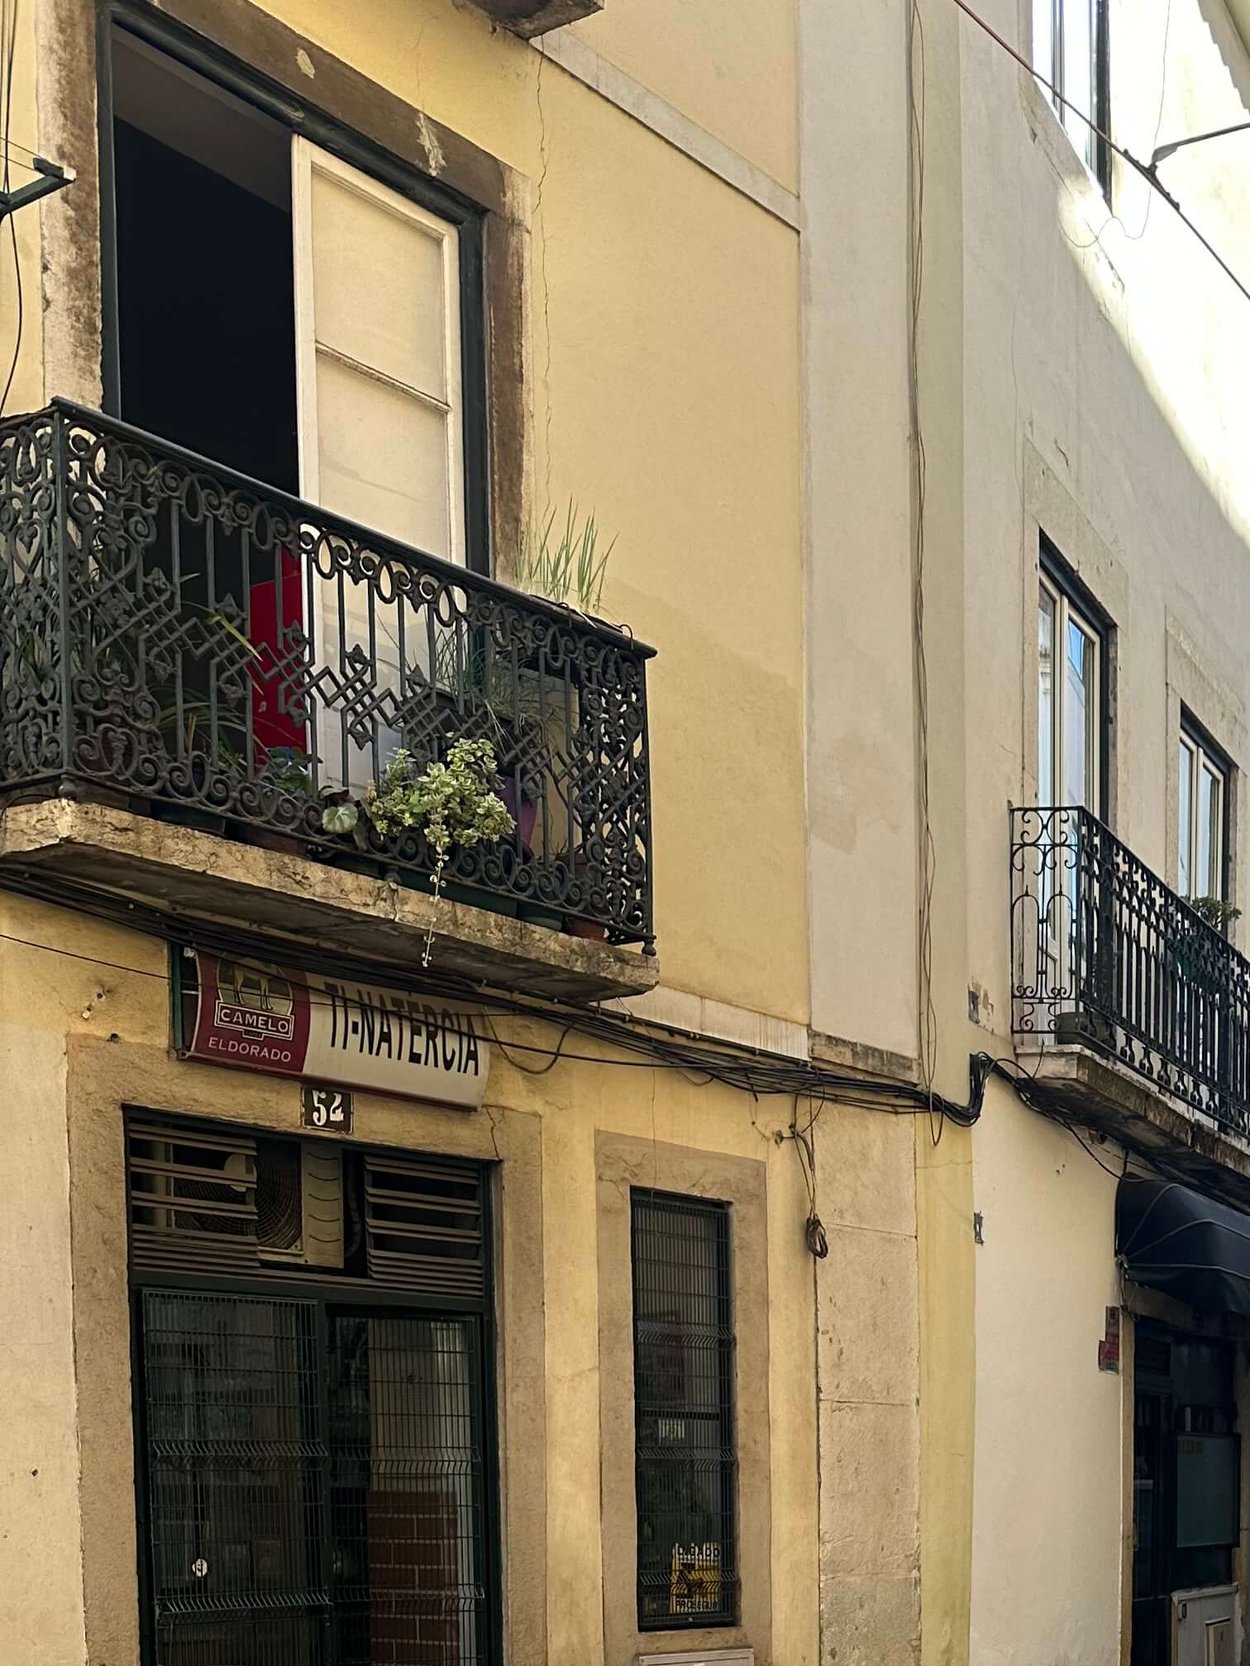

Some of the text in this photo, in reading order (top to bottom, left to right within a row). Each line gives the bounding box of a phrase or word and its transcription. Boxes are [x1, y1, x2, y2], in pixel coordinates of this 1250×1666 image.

[220, 1008, 290, 1034] CAMELO
[323, 981, 480, 1076] TI-NATERCIA
[207, 1036, 292, 1063] ELDORADO
[311, 1089, 345, 1127] 52
